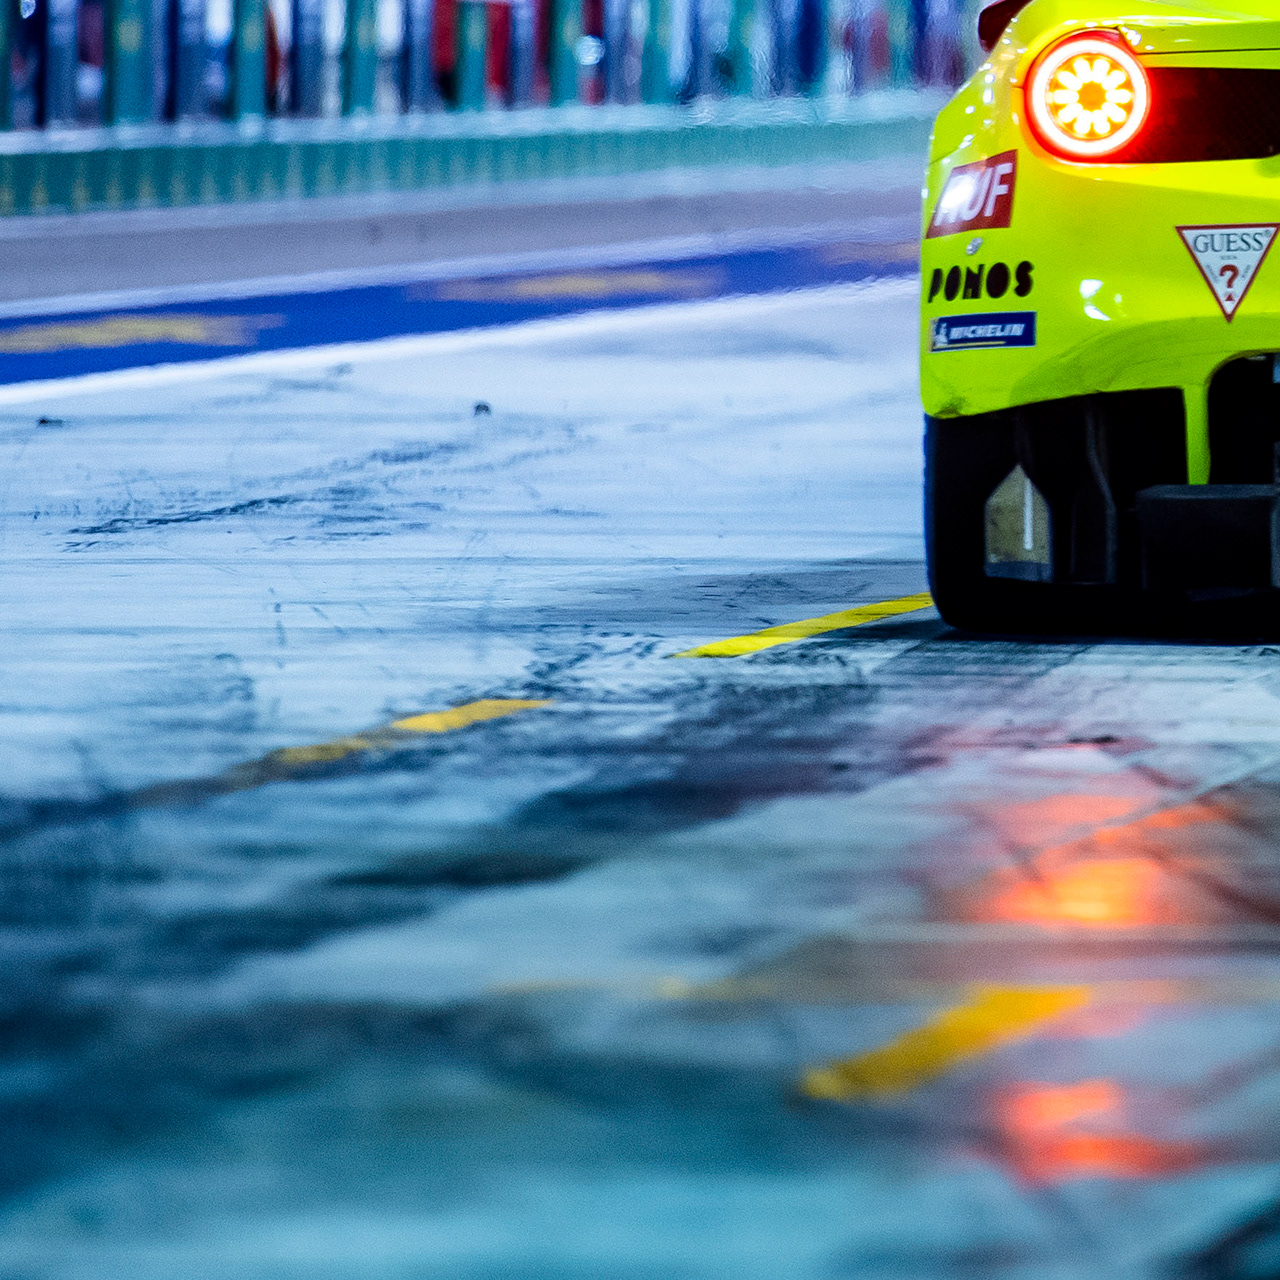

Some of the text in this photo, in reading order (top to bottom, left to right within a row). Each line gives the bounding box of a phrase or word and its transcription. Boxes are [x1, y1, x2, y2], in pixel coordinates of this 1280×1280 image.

[934, 162, 1014, 227] RUF
[928, 260, 1035, 304] PONOS
[950, 323, 1026, 341] MICHELIN
